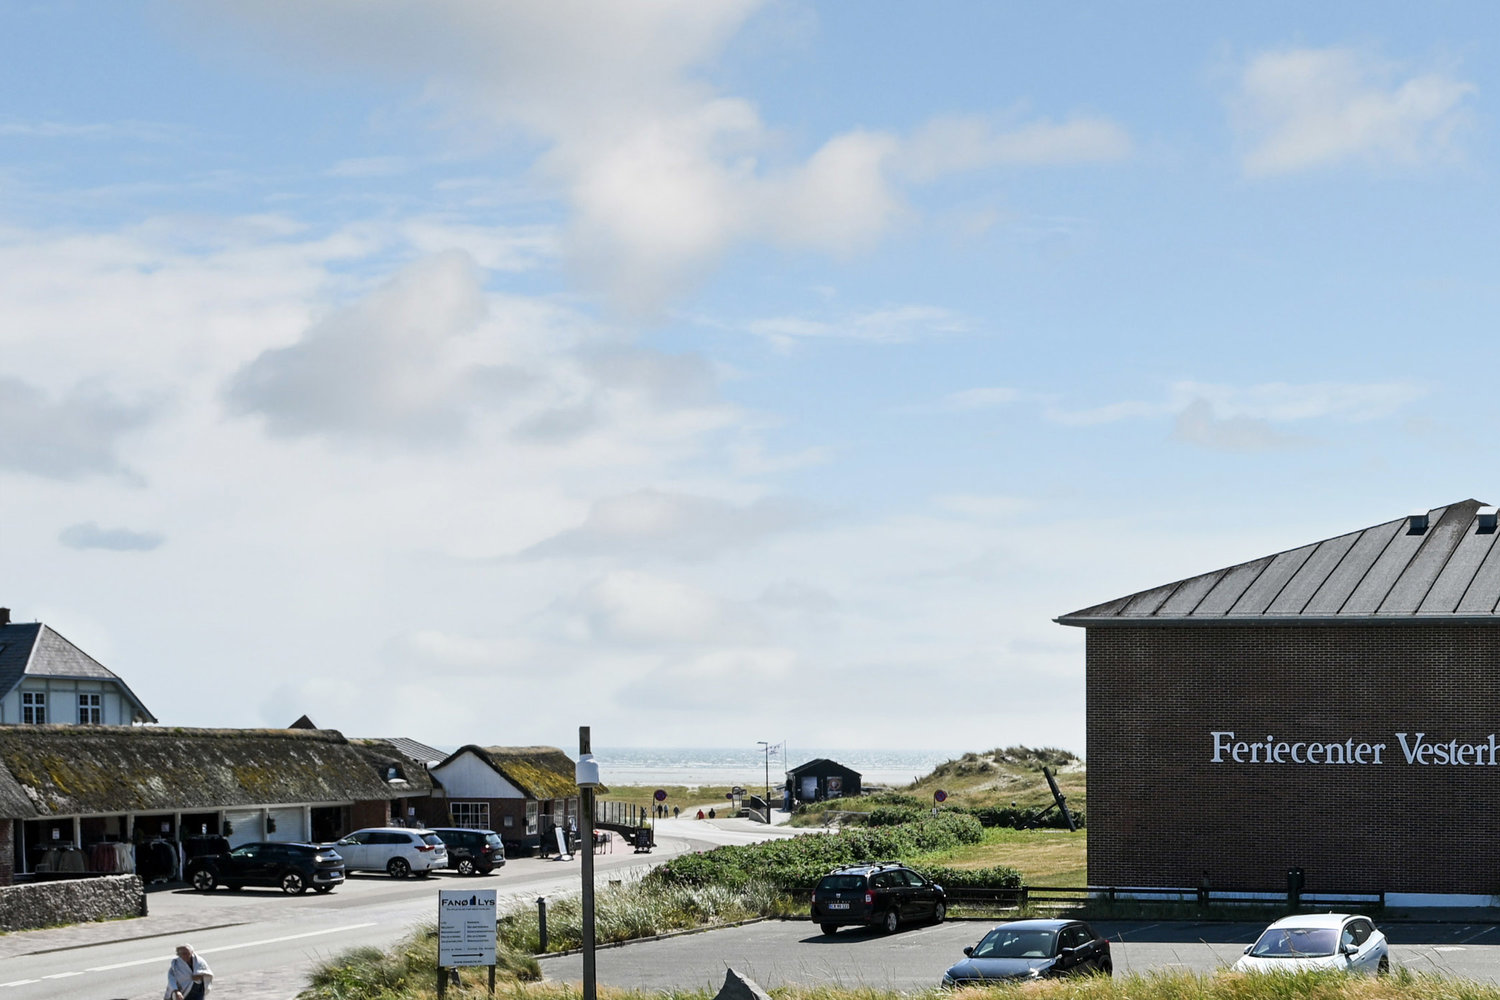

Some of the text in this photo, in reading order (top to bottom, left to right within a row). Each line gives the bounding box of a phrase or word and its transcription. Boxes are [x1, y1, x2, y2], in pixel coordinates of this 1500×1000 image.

[1210, 731, 1386, 764] Feriecenter
[441, 898, 495, 906] FANØ LYS
